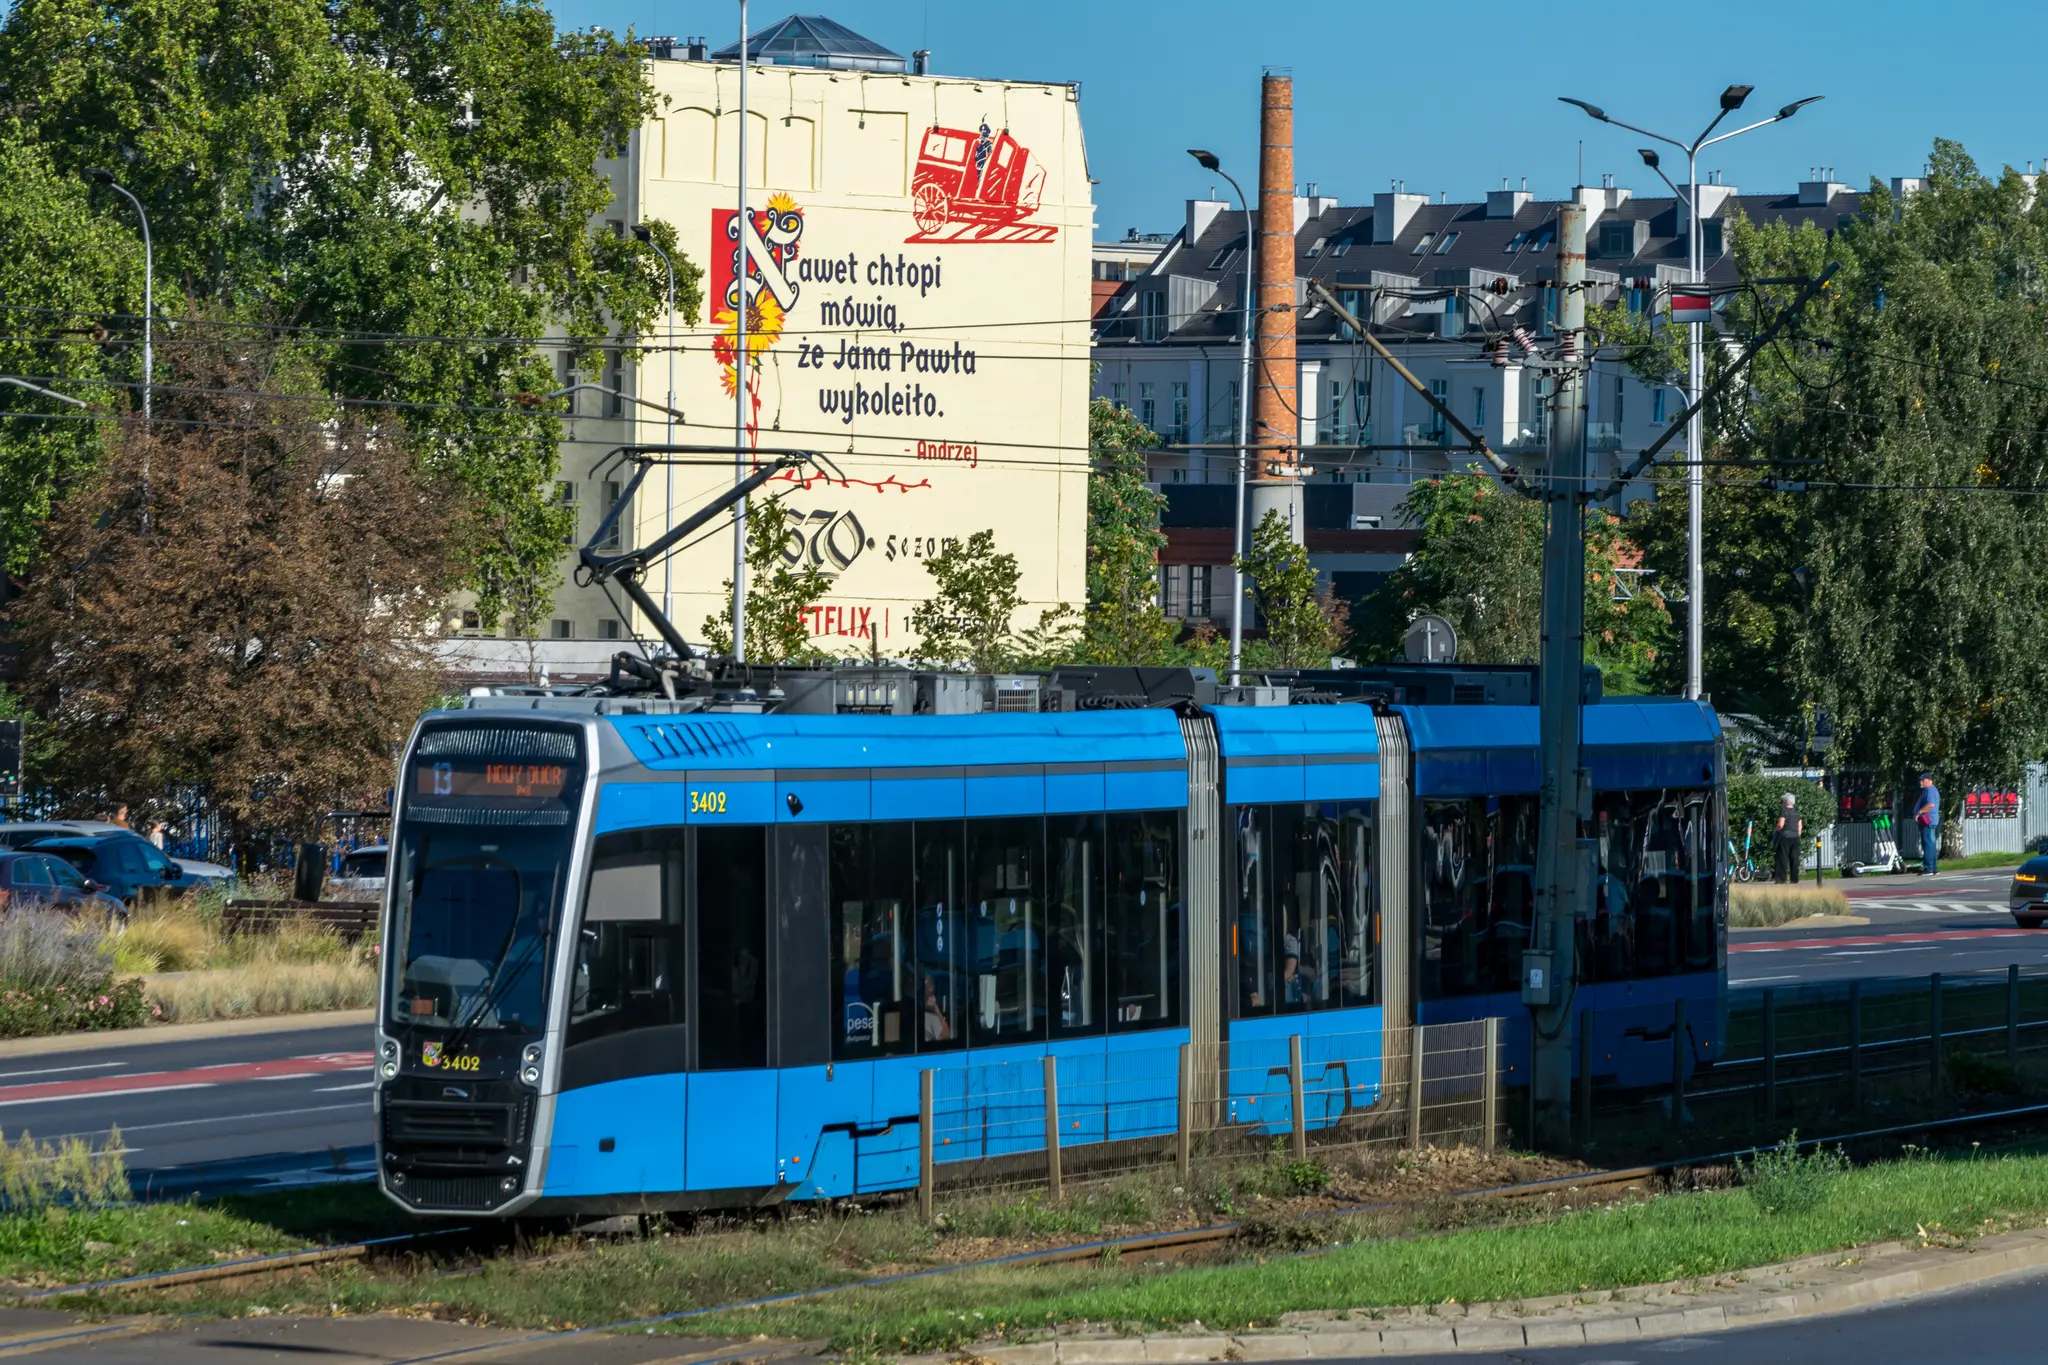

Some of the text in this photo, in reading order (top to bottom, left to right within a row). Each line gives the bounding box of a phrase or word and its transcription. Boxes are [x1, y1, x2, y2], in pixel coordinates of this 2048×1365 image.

[866, 253, 942, 298] chłopi
[821, 297, 905, 332] mówią,
[798, 336, 976, 375] że Jana Pawła
[819, 383, 944, 424] wykoleiło.
[917, 440, 978, 468] Andrzej
[784, 605, 871, 640] ETFLIX
[690, 791, 726, 813] 3402
[442, 1055, 480, 1071] 3402
